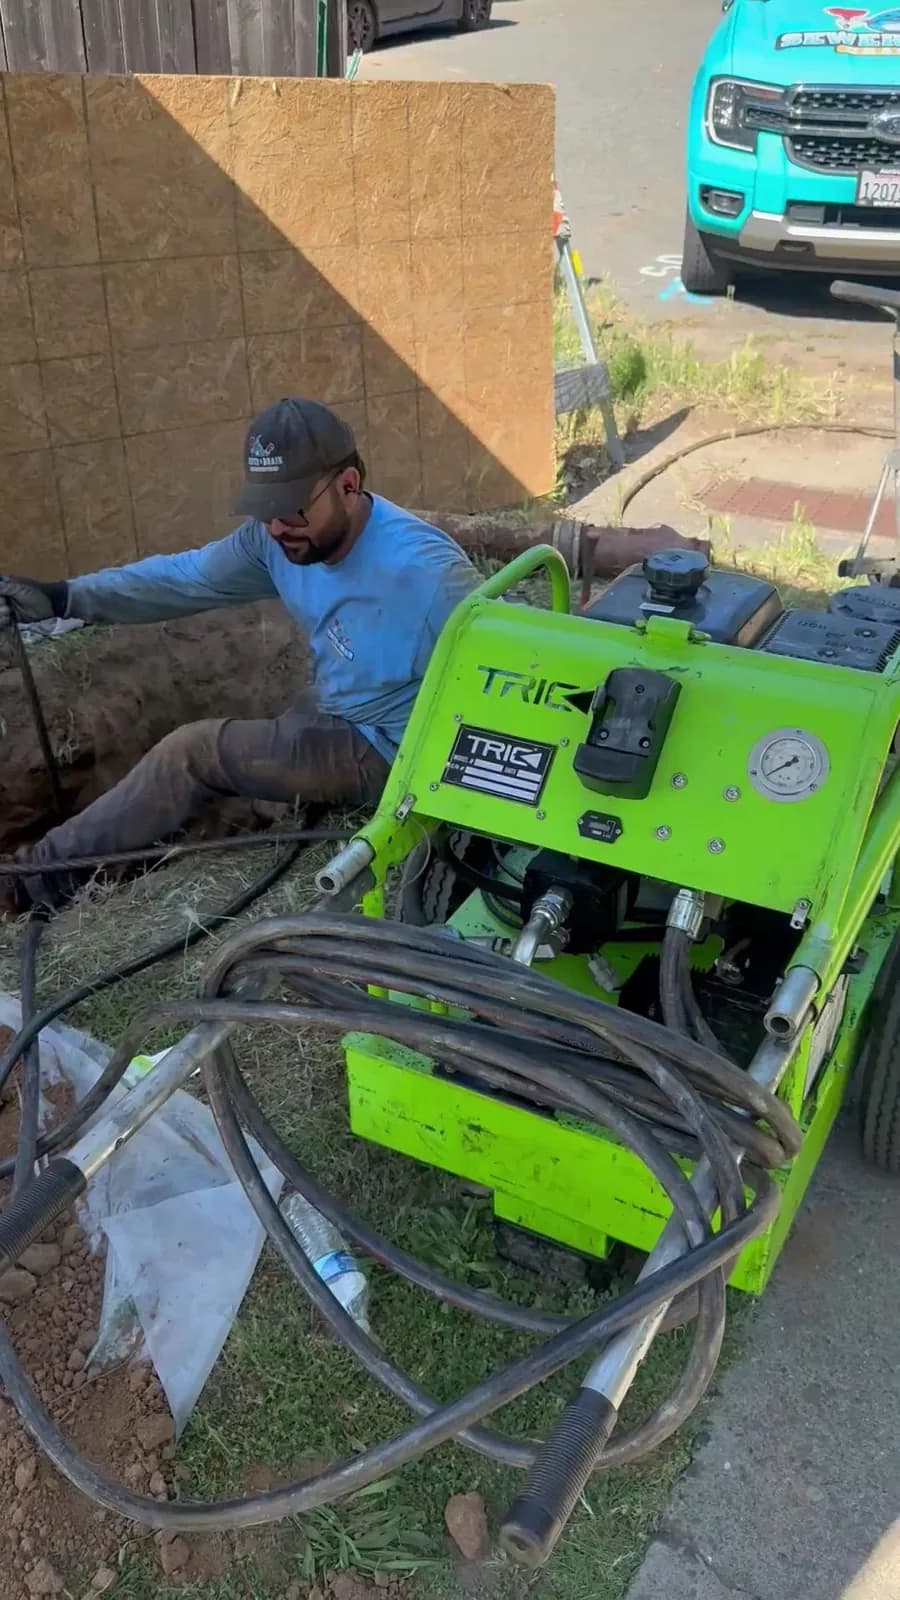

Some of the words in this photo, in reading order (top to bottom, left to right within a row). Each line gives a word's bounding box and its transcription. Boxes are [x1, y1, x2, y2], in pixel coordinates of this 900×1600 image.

[863, 182, 900, 201] 1207
[477, 664, 586, 713] TRIC
[467, 734, 541, 768] TRIC
